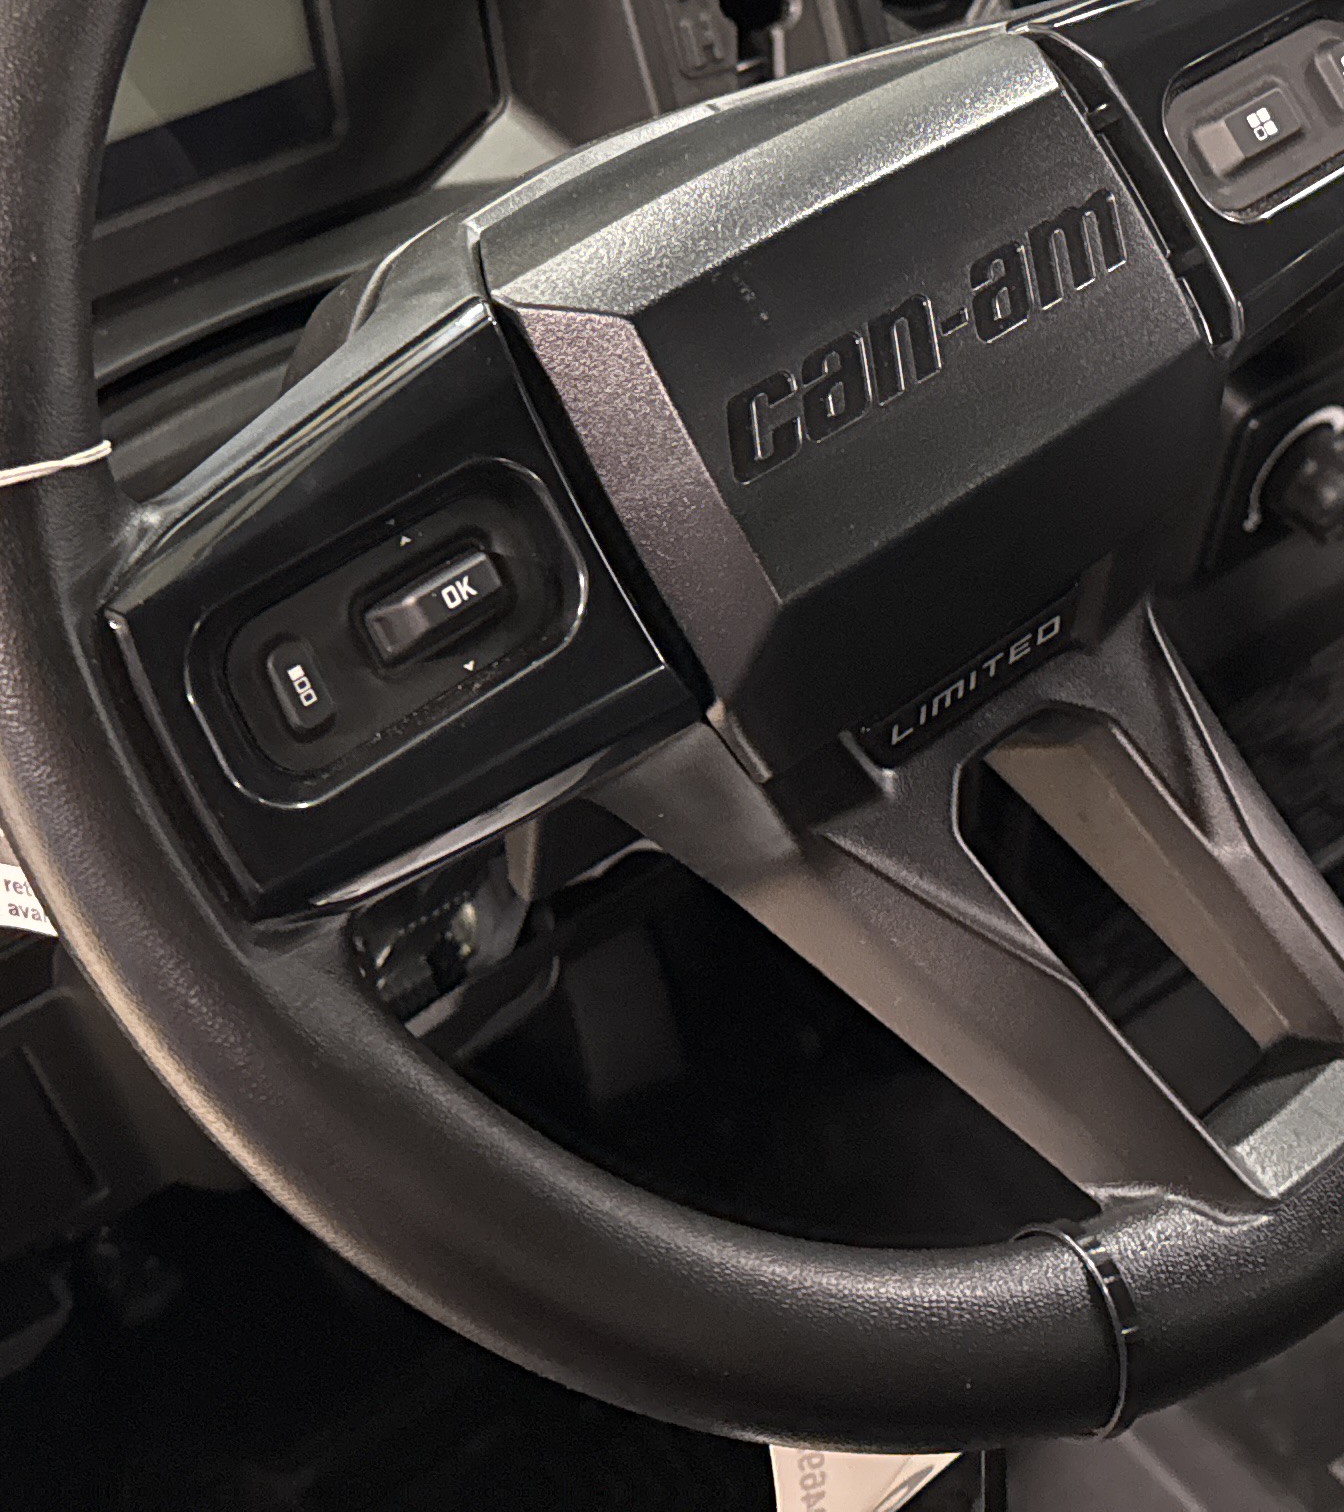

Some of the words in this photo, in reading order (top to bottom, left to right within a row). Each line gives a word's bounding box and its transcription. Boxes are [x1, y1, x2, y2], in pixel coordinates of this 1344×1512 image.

[726, 188, 1127, 485] can-am
[441, 575, 479, 609] OK
[889, 614, 1062, 746] LIMITED
